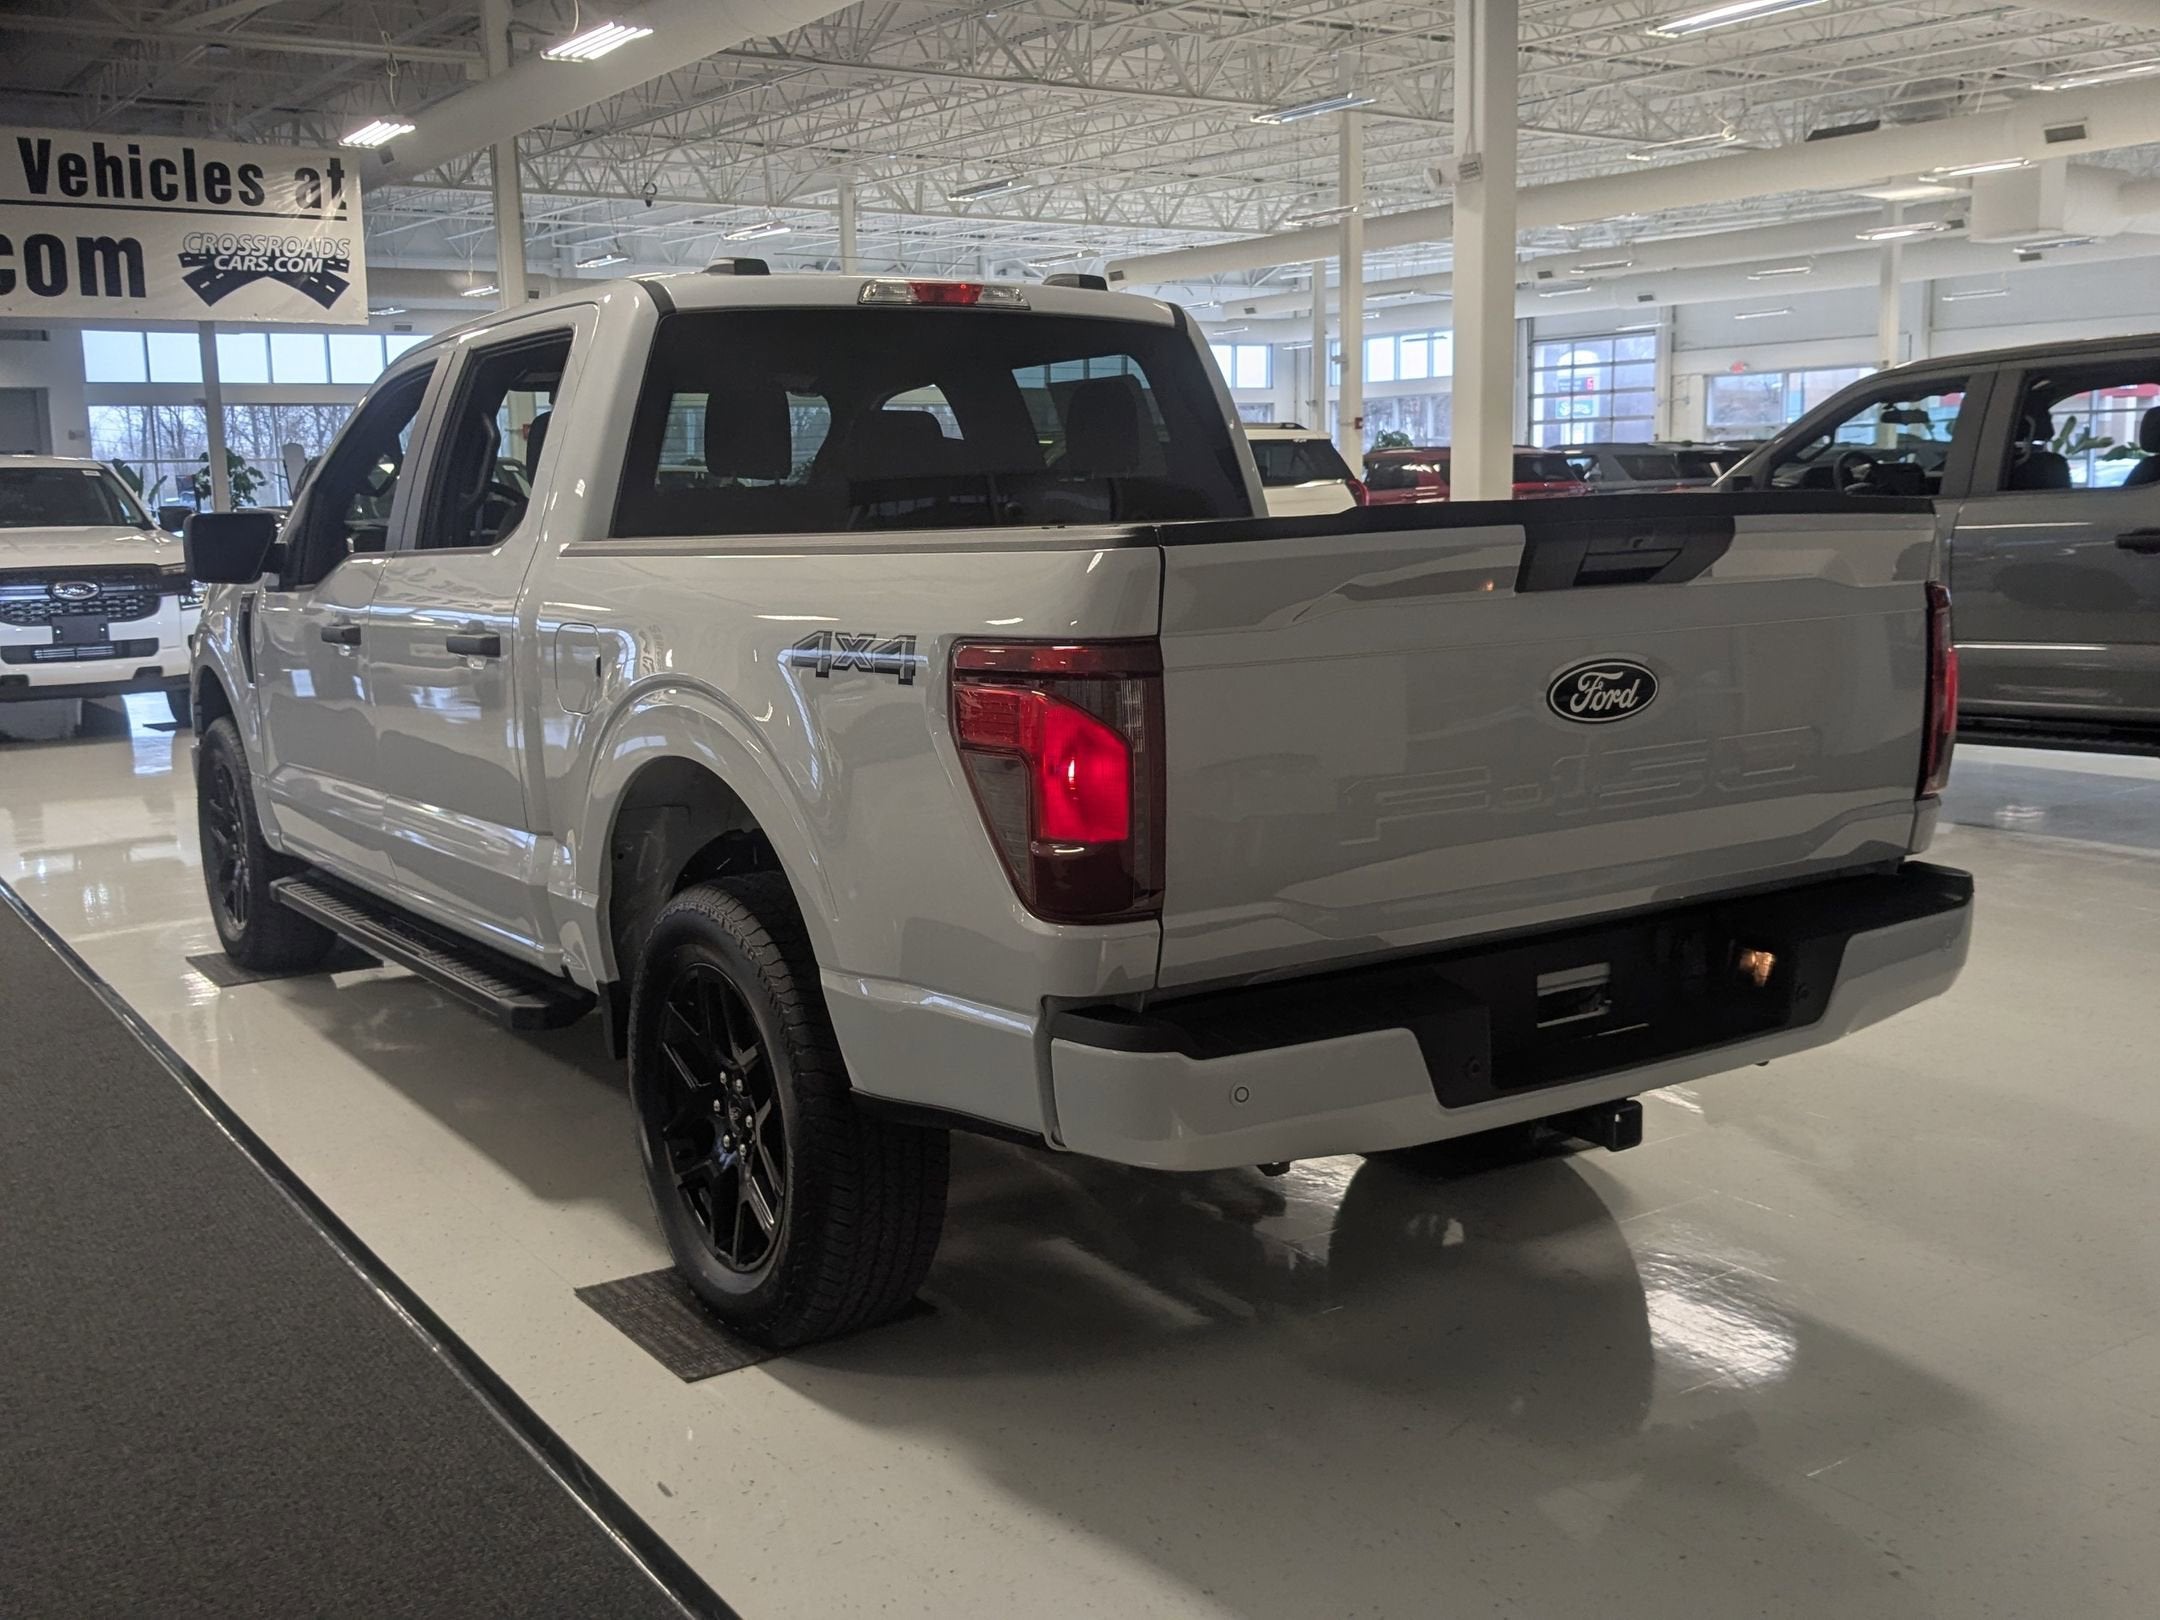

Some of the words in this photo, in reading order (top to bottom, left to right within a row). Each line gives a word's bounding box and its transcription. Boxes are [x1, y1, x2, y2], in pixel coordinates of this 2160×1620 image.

[16, 136, 266, 207] Vehicles
[293, 157, 347, 211] at
[182, 231, 350, 261] CROSSROADS
[213, 254, 324, 274] CARS.COM
[1569, 671, 1641, 713] Ford
